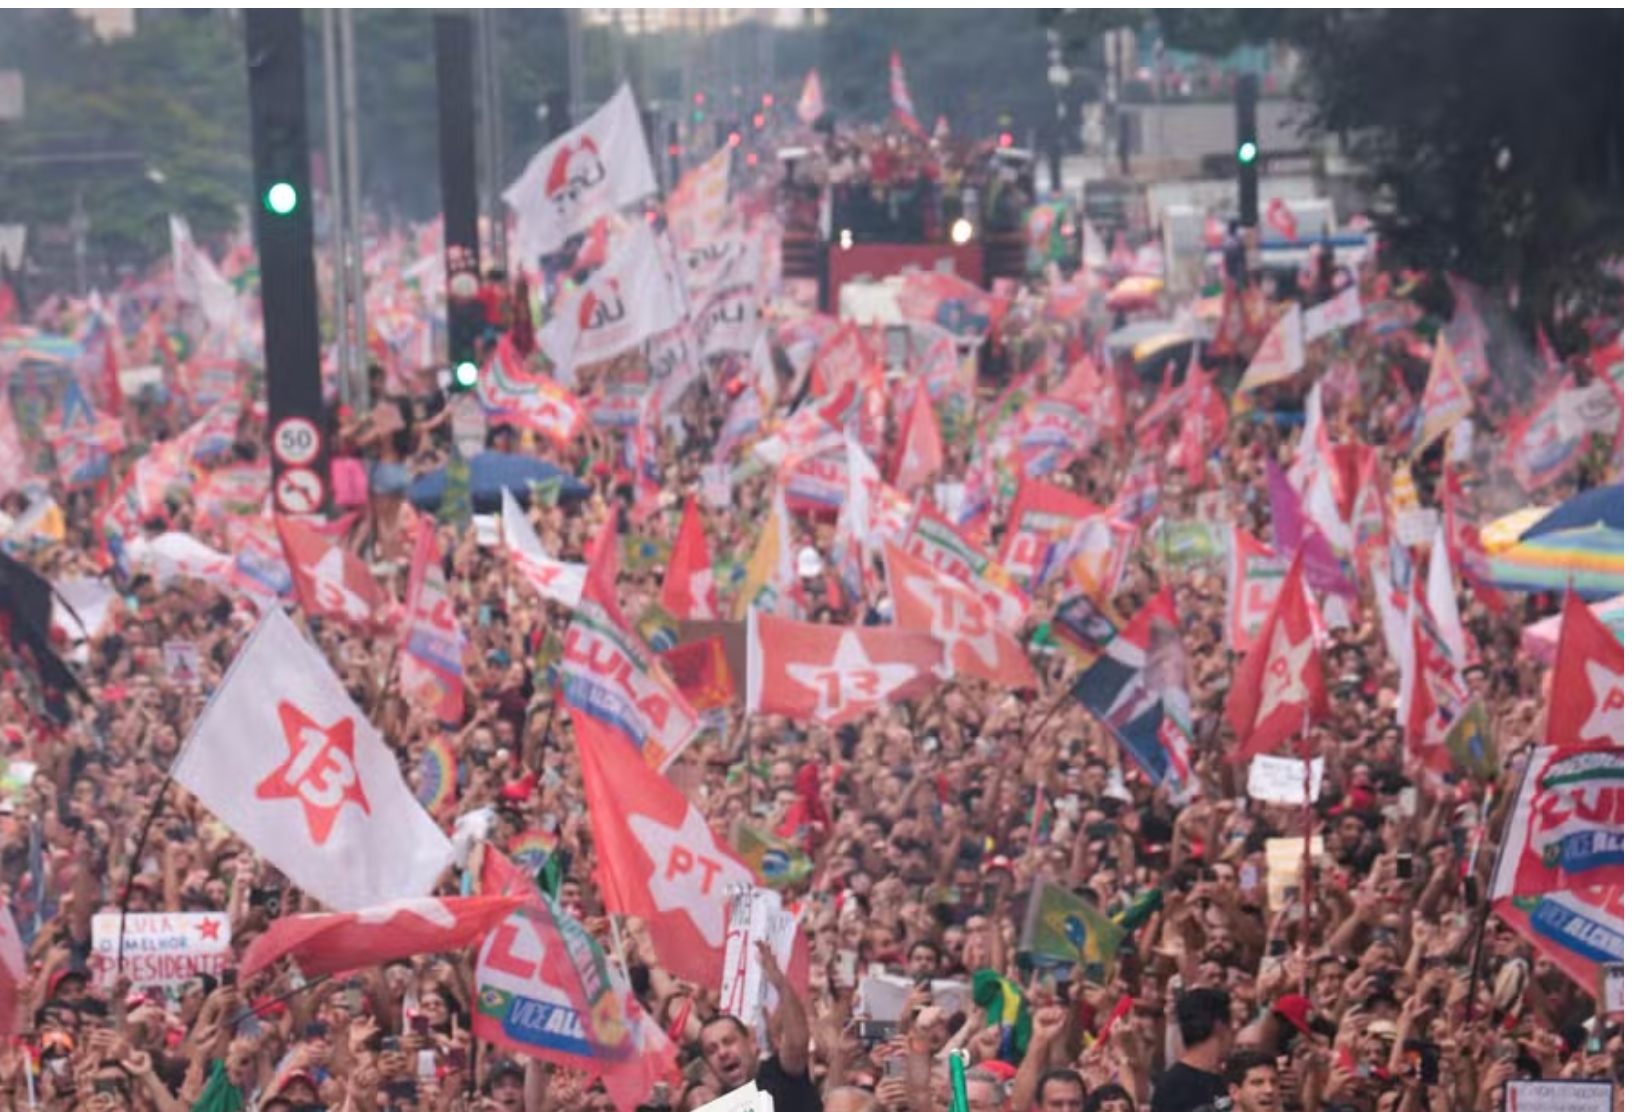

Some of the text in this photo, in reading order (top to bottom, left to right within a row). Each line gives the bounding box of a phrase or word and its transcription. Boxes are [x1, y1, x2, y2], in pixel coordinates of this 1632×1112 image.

[280, 430, 312, 449] 50
[933, 584, 986, 637] 13
[564, 627, 669, 732] LULA
[815, 669, 880, 709] 13
[284, 727, 357, 807] 13
[665, 845, 723, 896] PT
[125, 937, 188, 951] MELHOR
